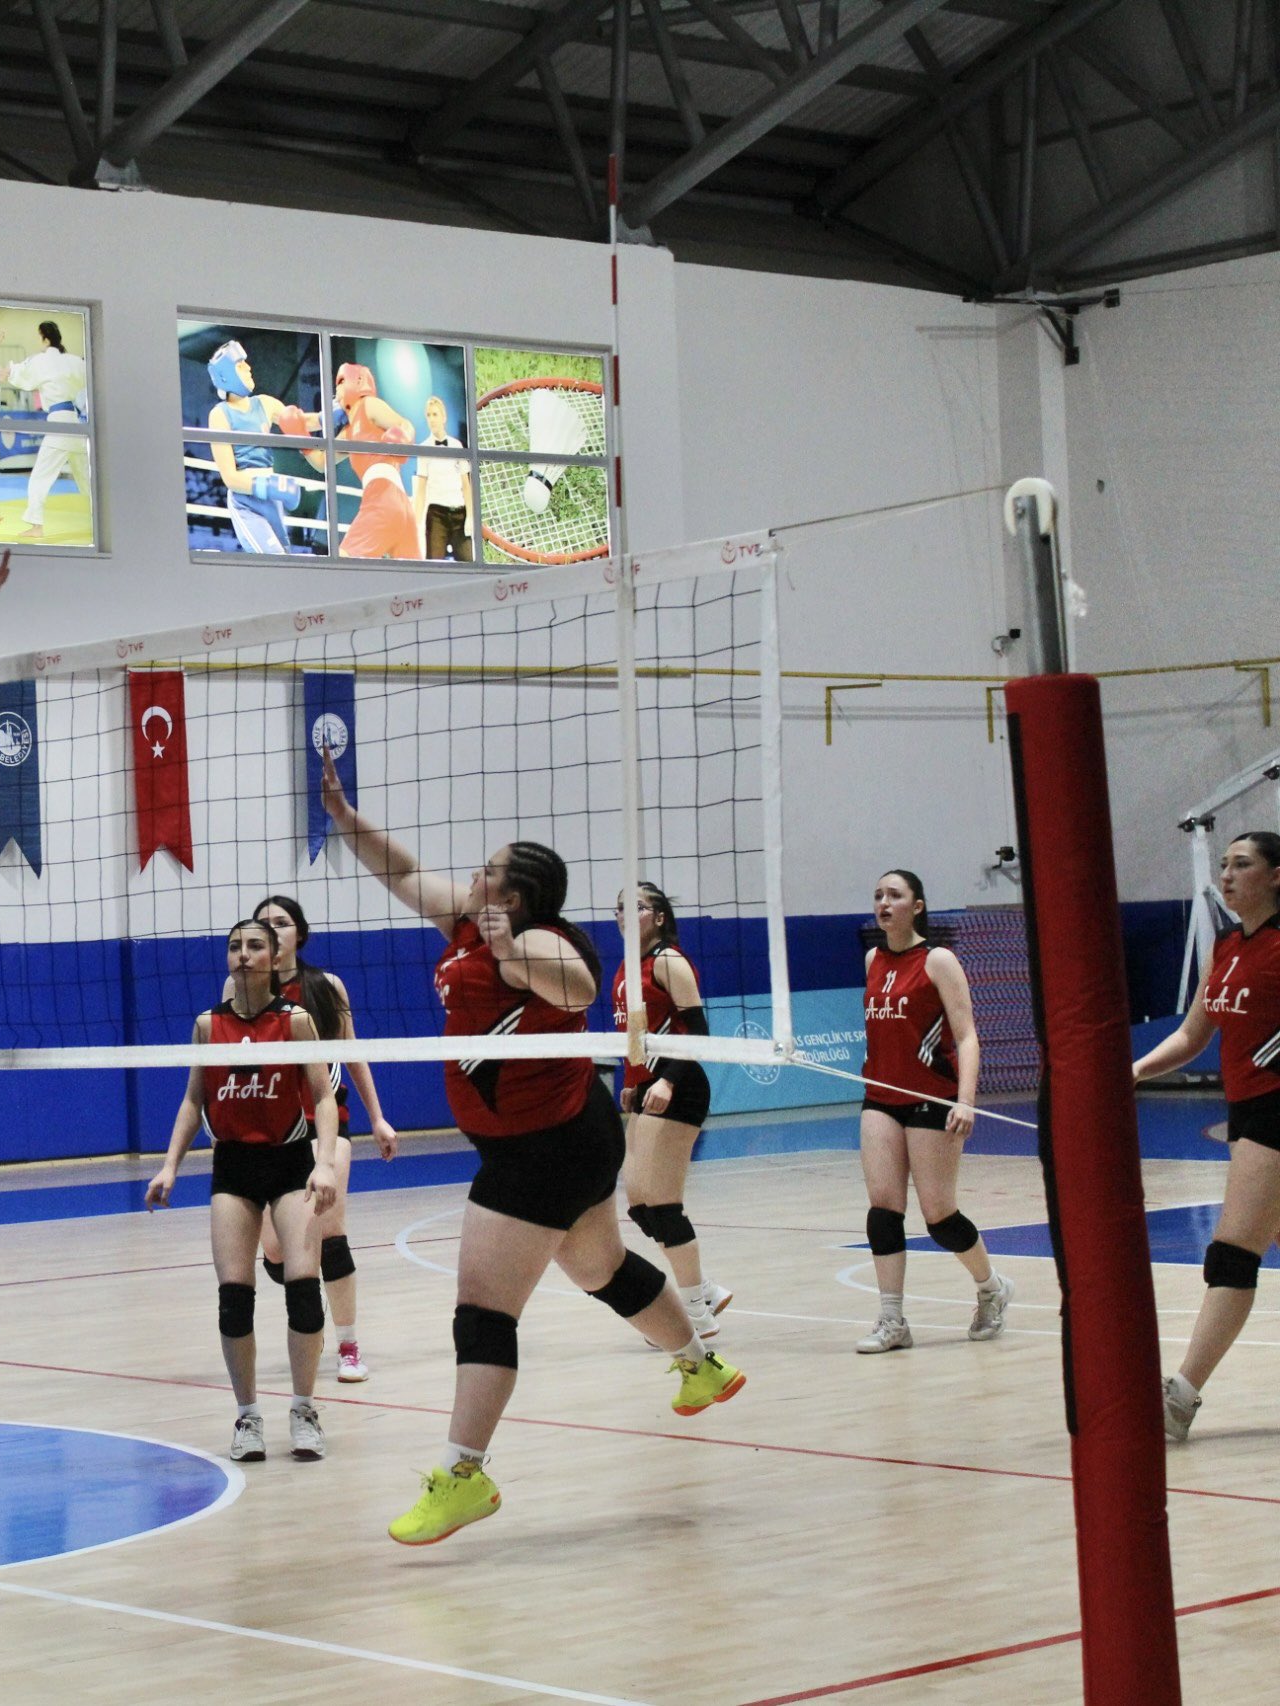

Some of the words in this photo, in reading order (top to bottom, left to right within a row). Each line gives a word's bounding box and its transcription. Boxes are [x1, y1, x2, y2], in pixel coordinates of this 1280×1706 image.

[46, 654, 62, 666] TVF
[128, 641, 144, 653] TVF
[215, 628, 232, 640] TVF
[307, 614, 325, 626] TVF
[405, 599, 423, 611] TVF
[508, 582, 528, 595] TVF
[882, 970, 898, 993] 11
[804, 1030, 841, 1047] GENÇLİK
[841, 1031, 854, 1043] VE
